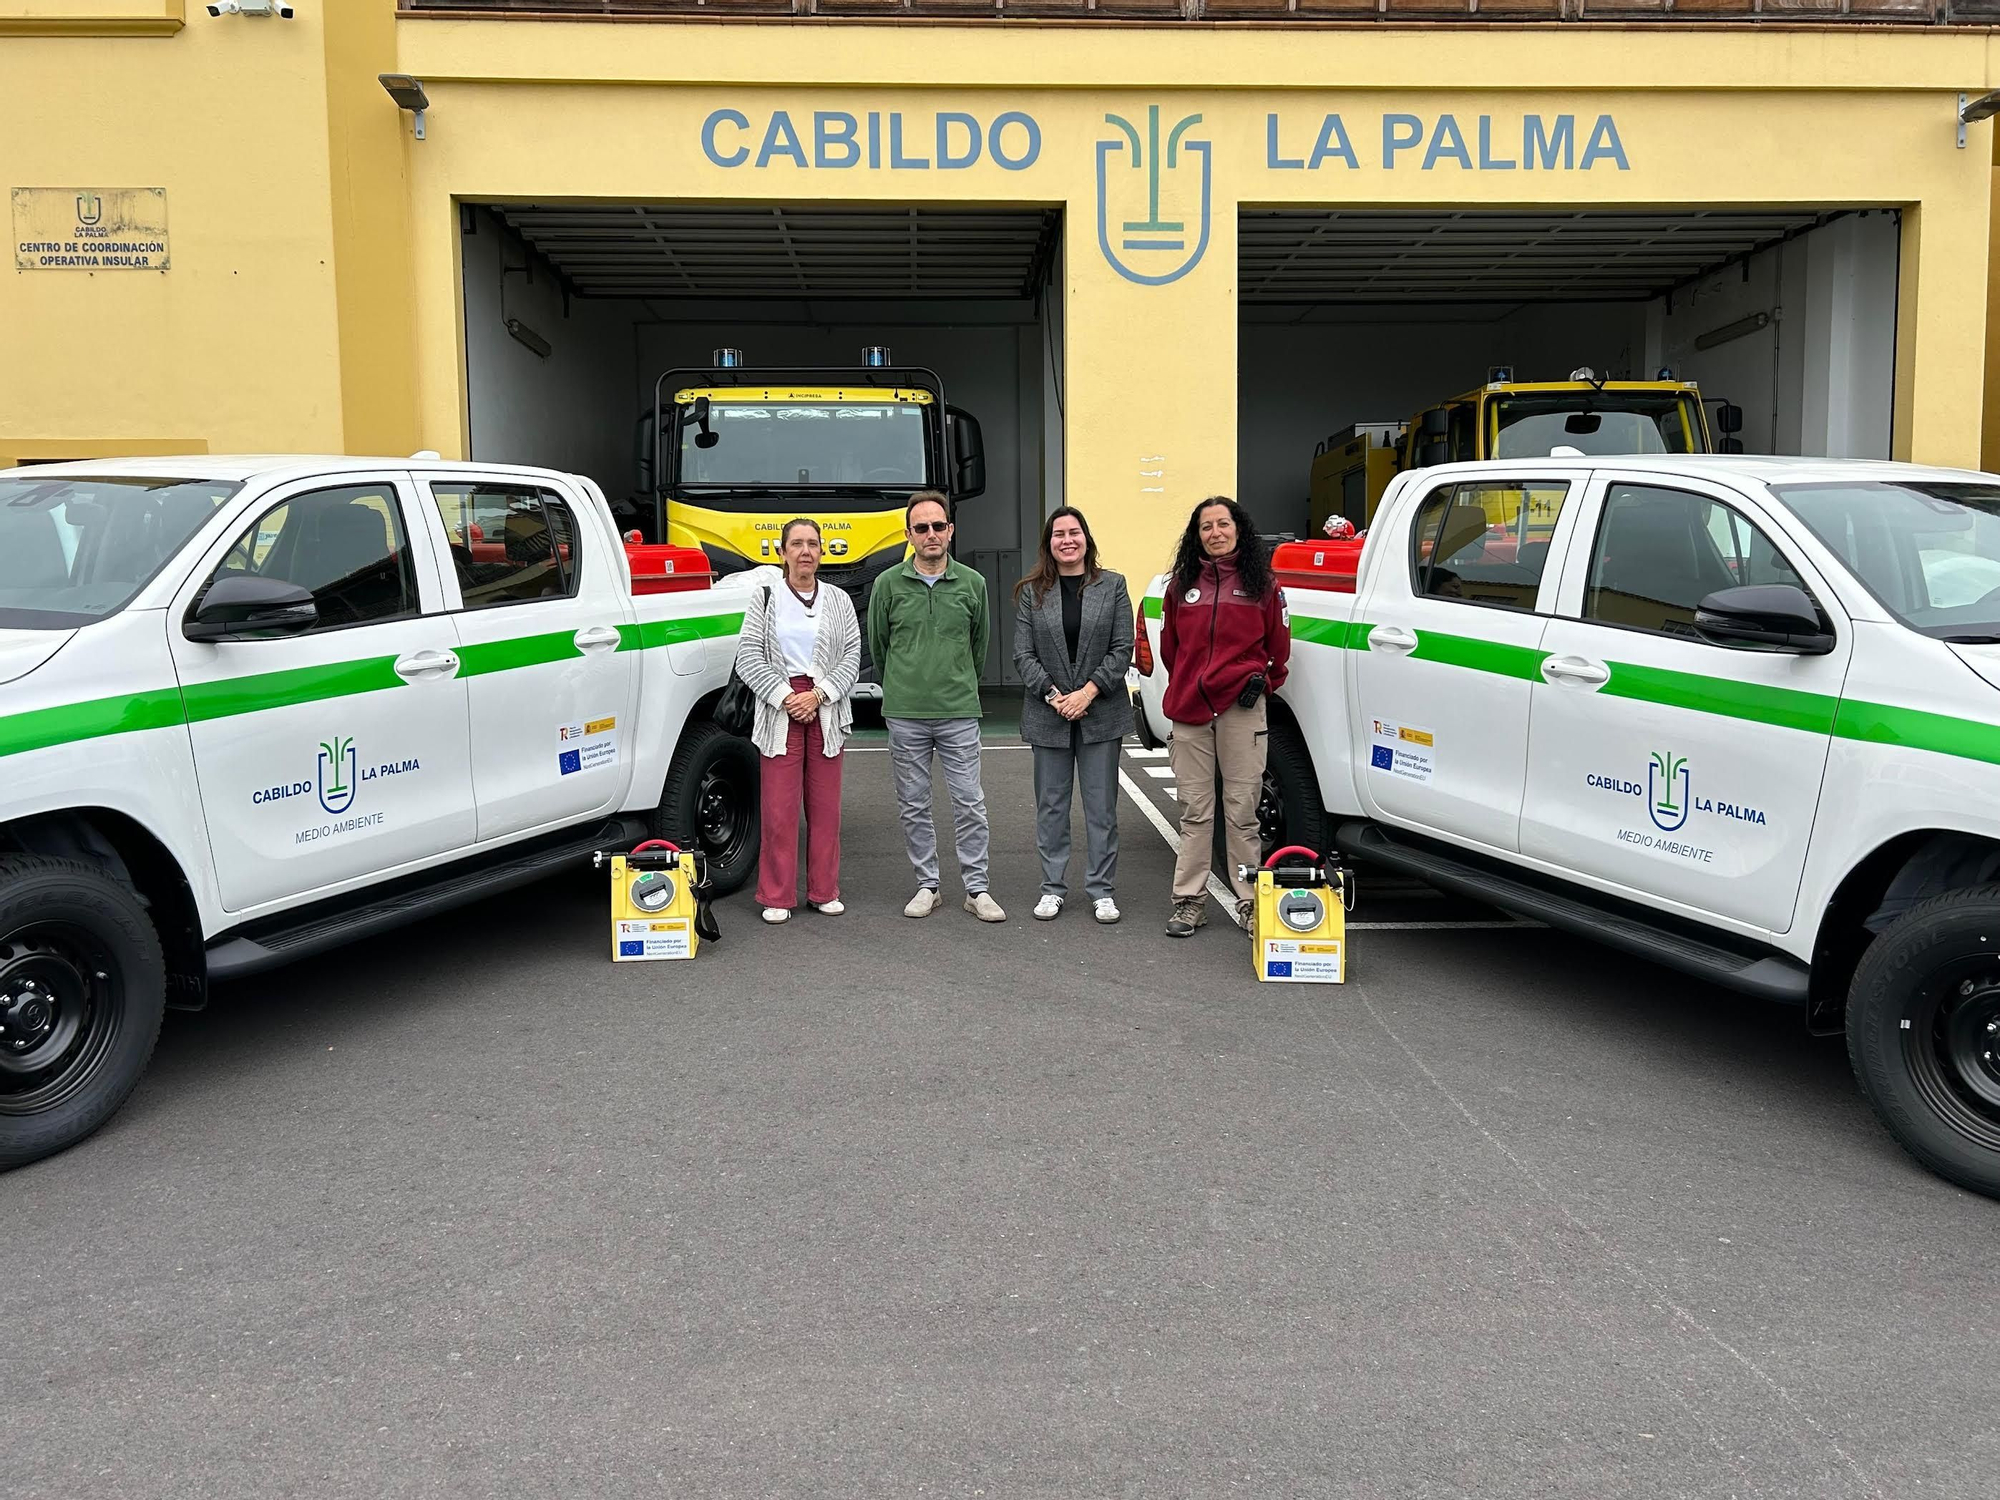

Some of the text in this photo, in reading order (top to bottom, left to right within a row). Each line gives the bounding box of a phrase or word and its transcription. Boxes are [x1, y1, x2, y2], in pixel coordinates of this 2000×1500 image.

[701, 109, 1631, 171] CABILDO LA PALMA
[19, 240, 164, 253] CENTRO DE COORDINACIÓN
[40, 256, 149, 266] OPERATIVA INSULAR
[823, 522, 852, 530] PALMA
[581, 743, 604, 753] Financiado
[587, 752, 599, 760] Unión
[599, 748, 616, 757] Europea
[1395, 750, 1419, 762] Financiado
[1399, 760, 1412, 768] Unión
[1413, 763, 1432, 773] Europea
[252, 759, 420, 804] CABILDO LA PALMA
[1586, 773, 1767, 826] CABILDO LA PALMA
[295, 812, 384, 844] MEDIO AMBIENTE
[1616, 829, 1714, 863] MEDIO AMBIENTE
